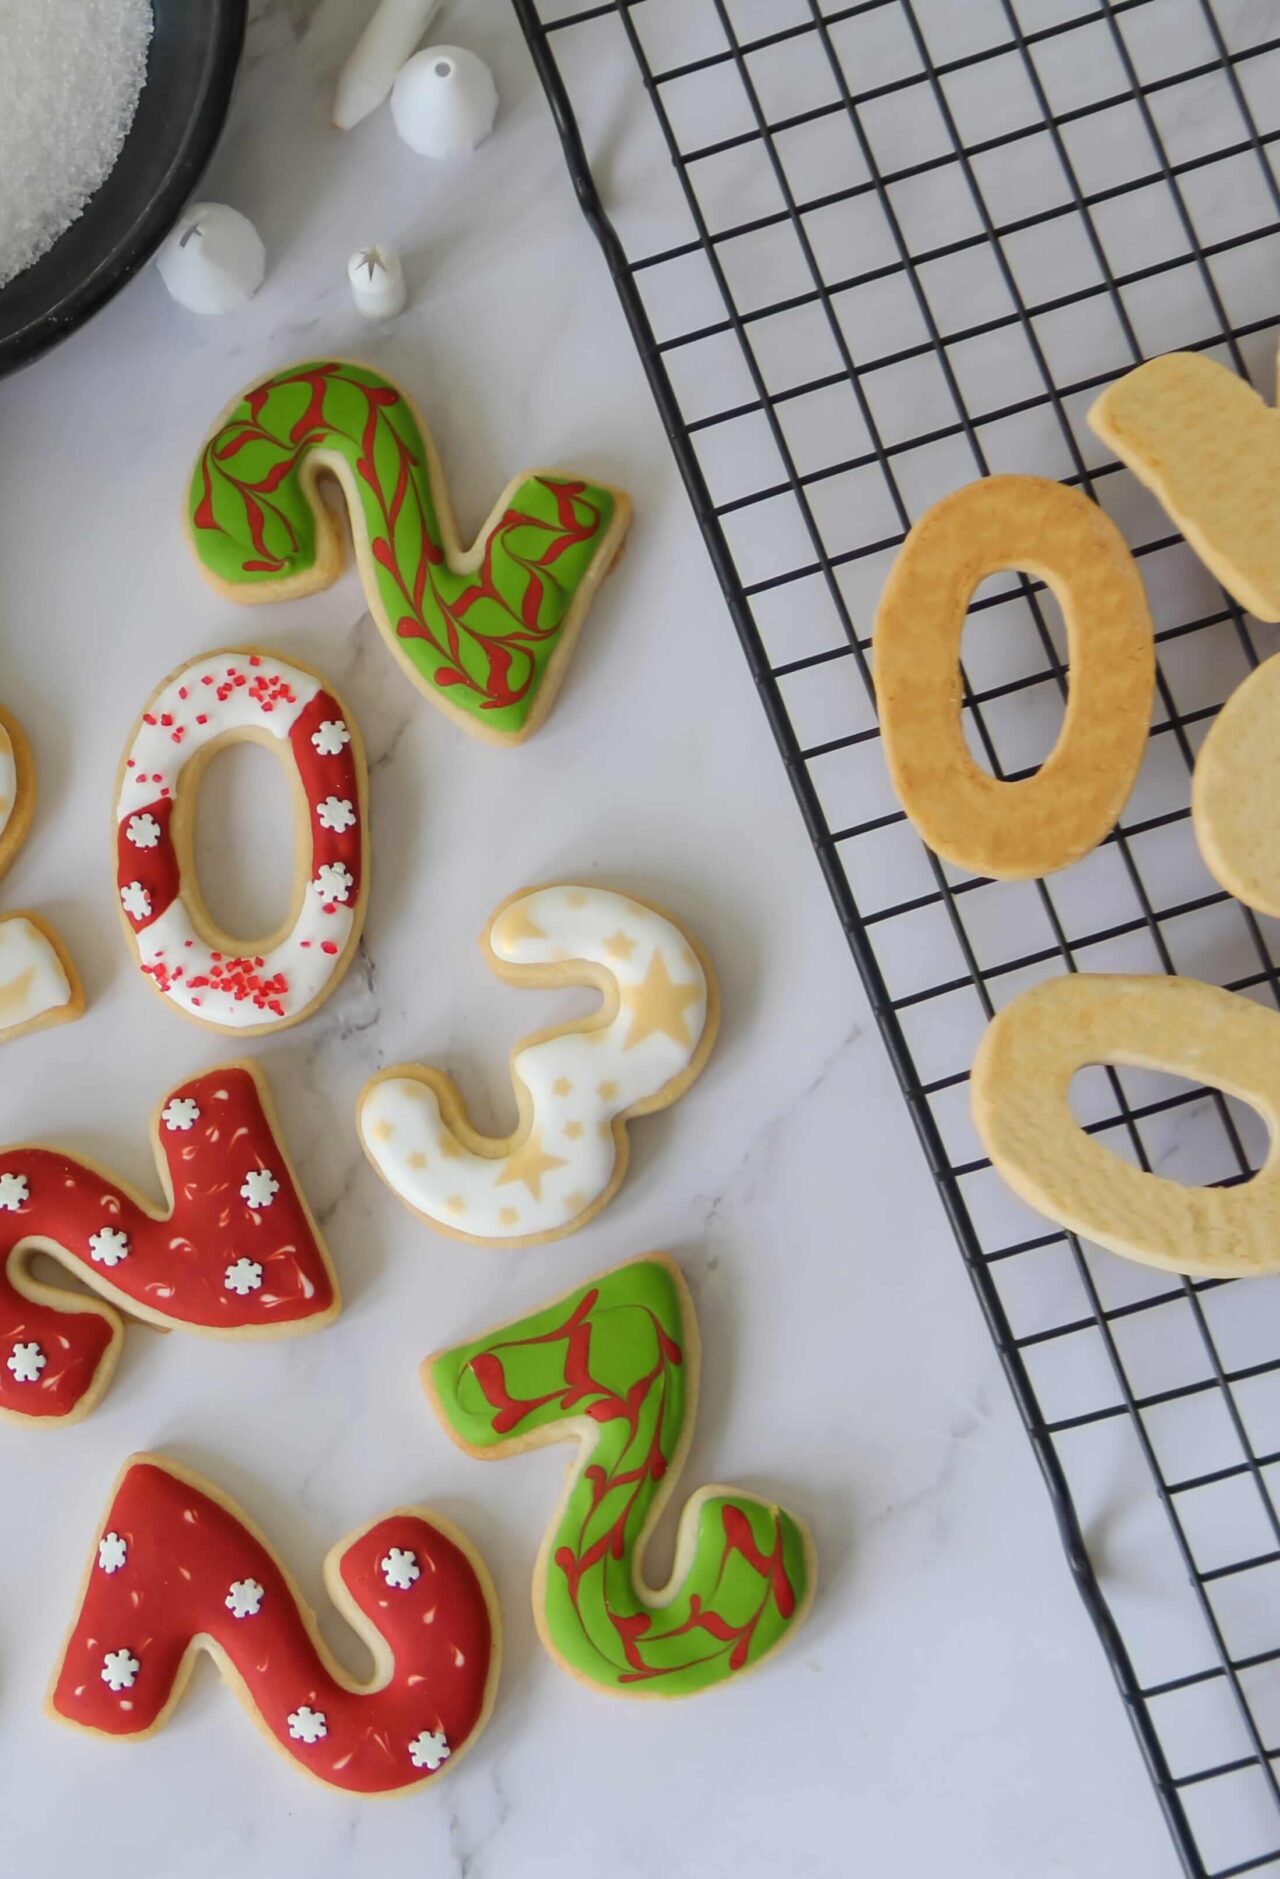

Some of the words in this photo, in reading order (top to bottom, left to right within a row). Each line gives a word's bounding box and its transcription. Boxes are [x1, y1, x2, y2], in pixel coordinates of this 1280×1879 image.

[182, 357, 632, 746] 2
[113, 646, 370, 1036] 0
[356, 882, 718, 1247] 3
